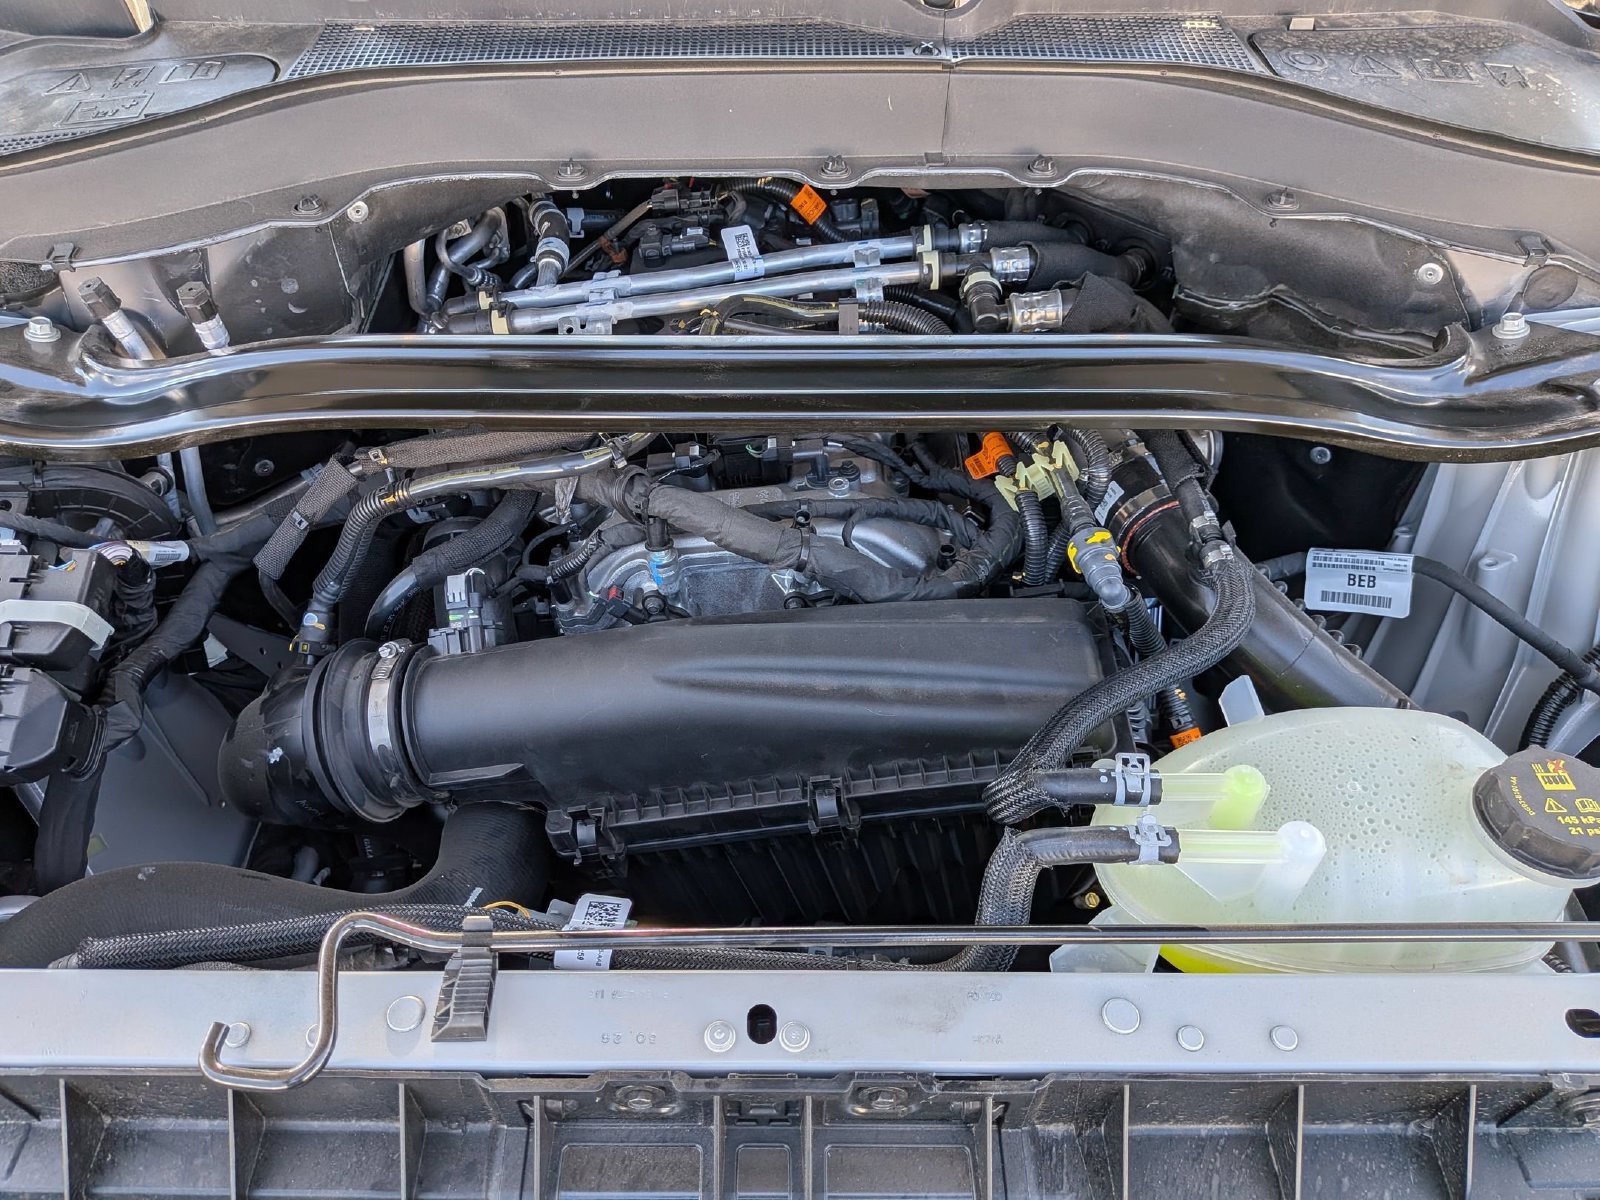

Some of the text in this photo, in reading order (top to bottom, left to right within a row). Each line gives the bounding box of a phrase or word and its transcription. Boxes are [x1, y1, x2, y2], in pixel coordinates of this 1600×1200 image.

[1347, 573, 1377, 589] BEB
[1557, 815, 1580, 825] 145
[1568, 826, 1584, 835] 21
